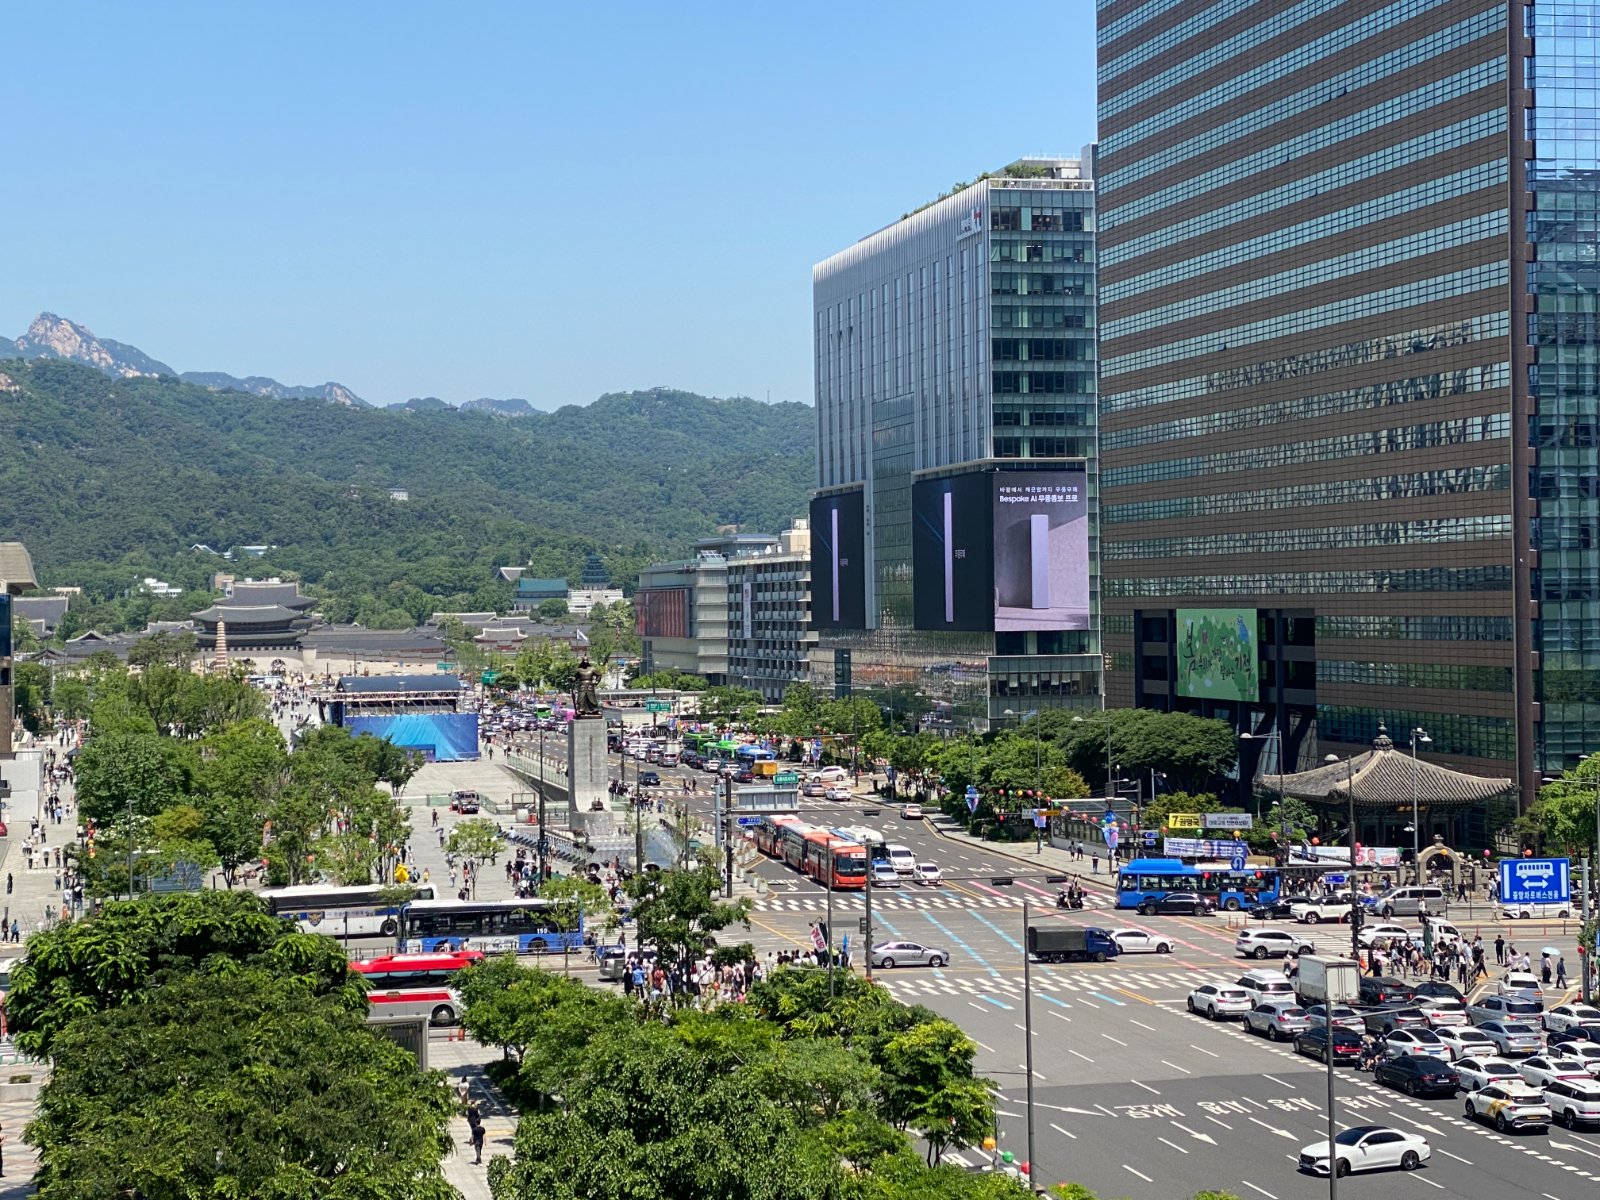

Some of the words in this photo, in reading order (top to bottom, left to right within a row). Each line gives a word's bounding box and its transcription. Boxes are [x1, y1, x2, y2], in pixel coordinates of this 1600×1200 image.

[999, 495, 1030, 504] Bespoke
[1038, 494, 1064, 503] 무풍콤보
[1064, 494, 1078, 502] 프로
[1172, 815, 1178, 826] 7
